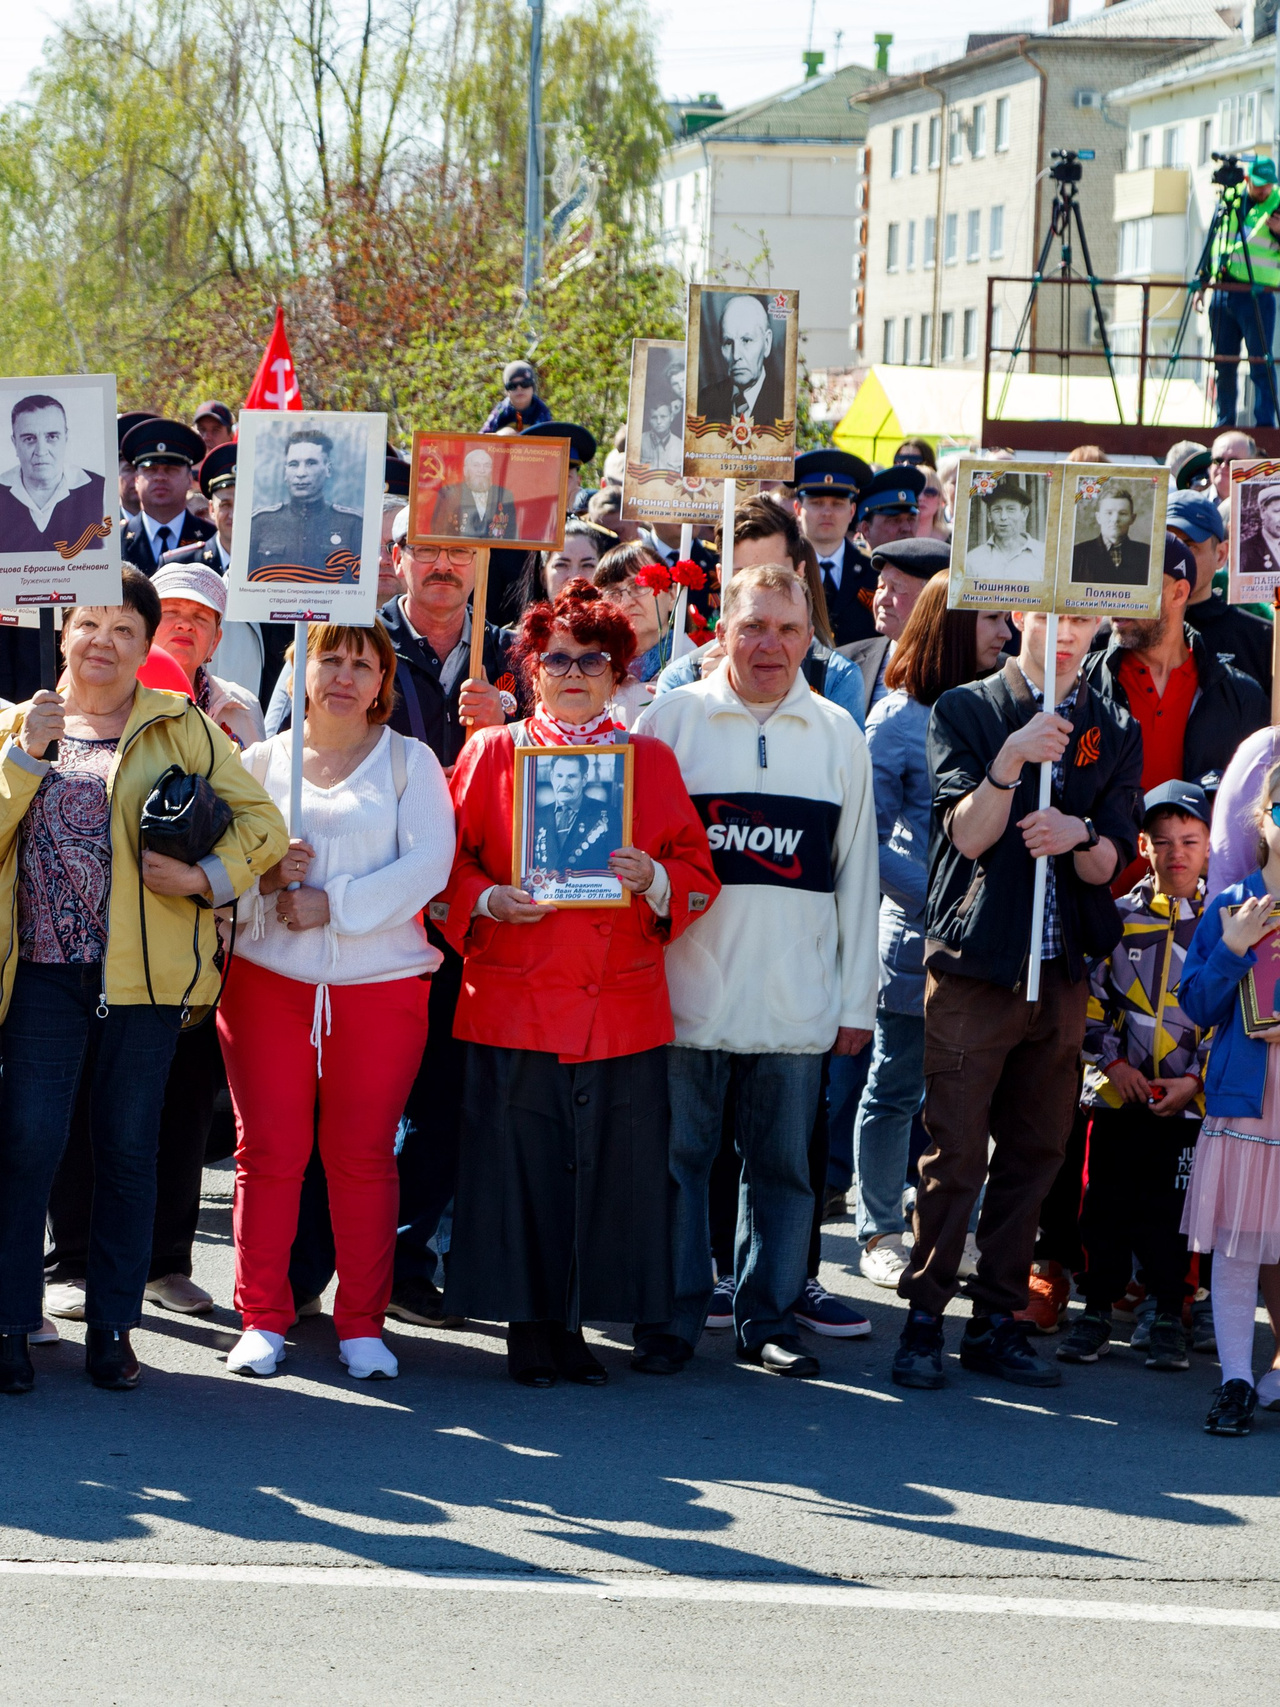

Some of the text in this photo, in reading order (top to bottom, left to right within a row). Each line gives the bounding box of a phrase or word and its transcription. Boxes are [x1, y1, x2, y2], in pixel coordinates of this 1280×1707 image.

[523, 447, 561, 457] Александр
[685, 451, 721, 460] Афанасьев
[747, 453, 792, 463] Афанасьевич
[510, 454, 545, 463] Иванович
[720, 463, 758, 471] 1917-1999
[628, 497, 671, 507] Леонид
[672, 499, 719, 510] Василий
[638, 508, 672, 517] Экипаж
[23, 564, 65, 574] Ефросинья
[67, 563, 109, 571] Семёновна
[20, 577, 51, 585] Труженик
[973, 580, 1030, 593] Тюшняков
[1085, 587, 1131, 599] Поляков
[962, 594, 1041, 604] Михаил Никитьевич
[1065, 599, 1149, 610] Василий Михайлович
[725, 816, 750, 825] LET IT
[706, 824, 805, 856] SNOW
[1178, 1146, 1196, 1162] JU
[1174, 1174, 1190, 1191] IT
